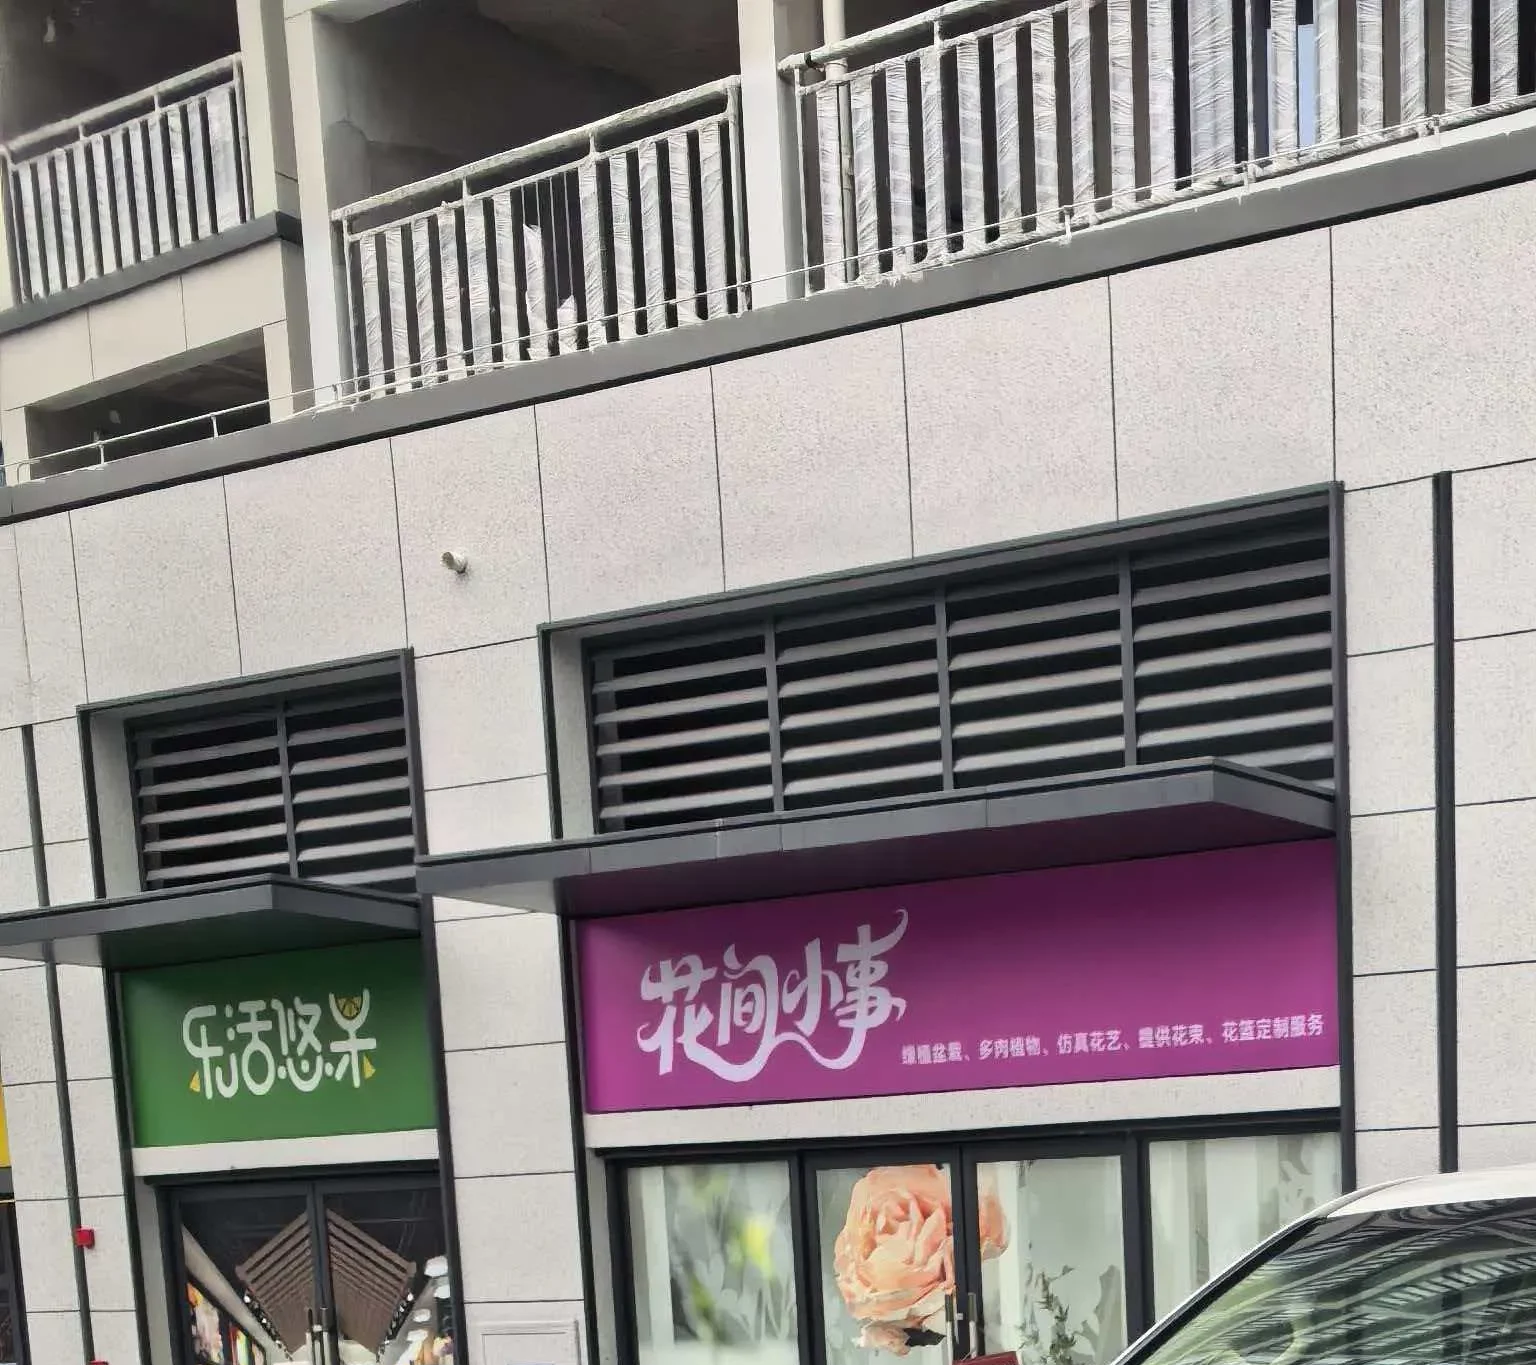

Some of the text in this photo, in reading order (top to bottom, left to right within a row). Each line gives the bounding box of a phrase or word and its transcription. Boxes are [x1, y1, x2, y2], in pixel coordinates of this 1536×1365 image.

[182, 988, 377, 1100] 乐活悠果
[636, 908, 909, 1083] 花间小事
